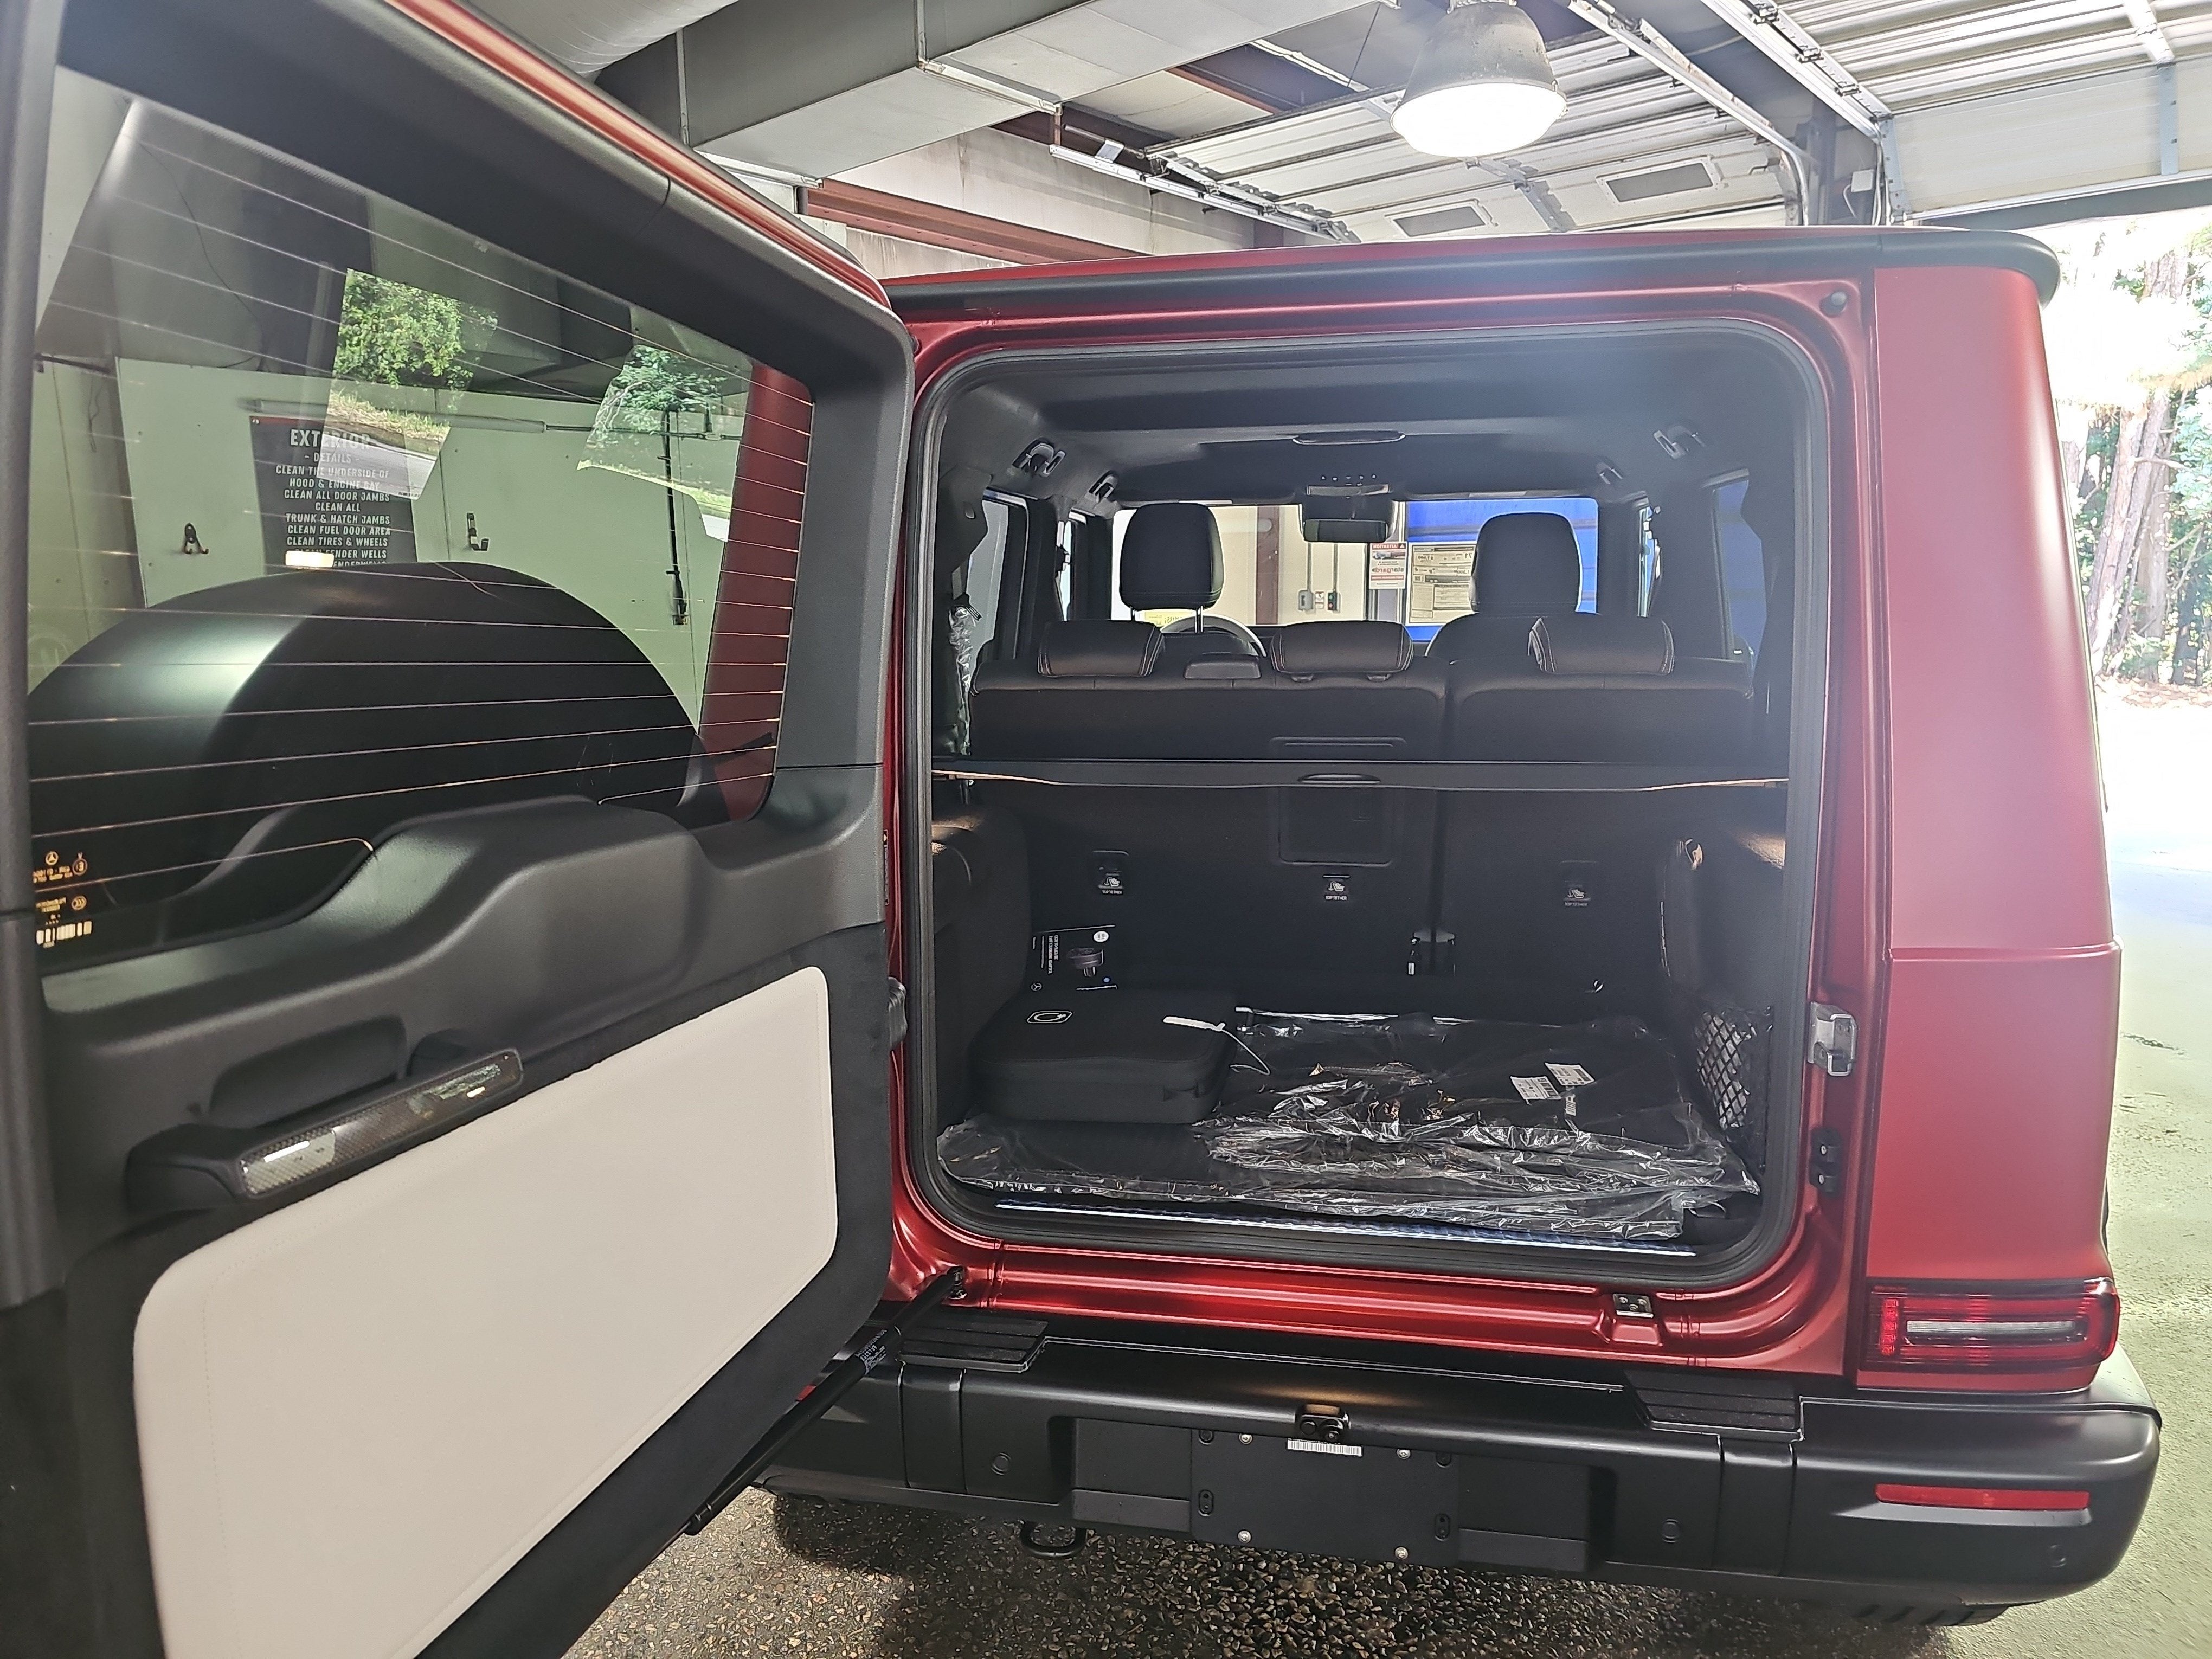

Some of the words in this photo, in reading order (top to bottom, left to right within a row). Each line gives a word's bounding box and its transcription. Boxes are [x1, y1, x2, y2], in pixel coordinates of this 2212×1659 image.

[290, 429, 370, 449] EXTERIOR
[313, 452, 351, 463] DETAILS
[276, 465, 305, 475] CLEAN
[308, 466, 324, 476] THE
[328, 467, 376, 478] UNDERSIDE
[380, 470, 389, 478] OF
[290, 478, 314, 488] HOOD
[318, 479, 325, 488] &
[329, 479, 361, 490] ENGINE
[284, 489, 312, 499] CLEAN
[316, 490, 331, 500] ALL
[334, 491, 358, 501] DOOR
[361, 492, 390, 502] JAMBS
[316, 502, 343, 512] CLEAN
[346, 502, 361, 512] ALL
[286, 513, 317, 523] TRUNK
[320, 514, 326, 524] &
[330, 515, 358, 524] HATCH
[361, 515, 390, 525] JAMBS
[287, 525, 316, 535] CLEAN
[319, 525, 340, 535] FUEL
[343, 526, 366, 535] DOOR
[369, 526, 390, 536] AREA
[287, 536, 314, 546] CLEAN
[318, 536, 343, 546] TIRES
[345, 537, 352, 546] &
[356, 537, 388, 547] WHEELS
[361, 549, 387, 559] WELLS
